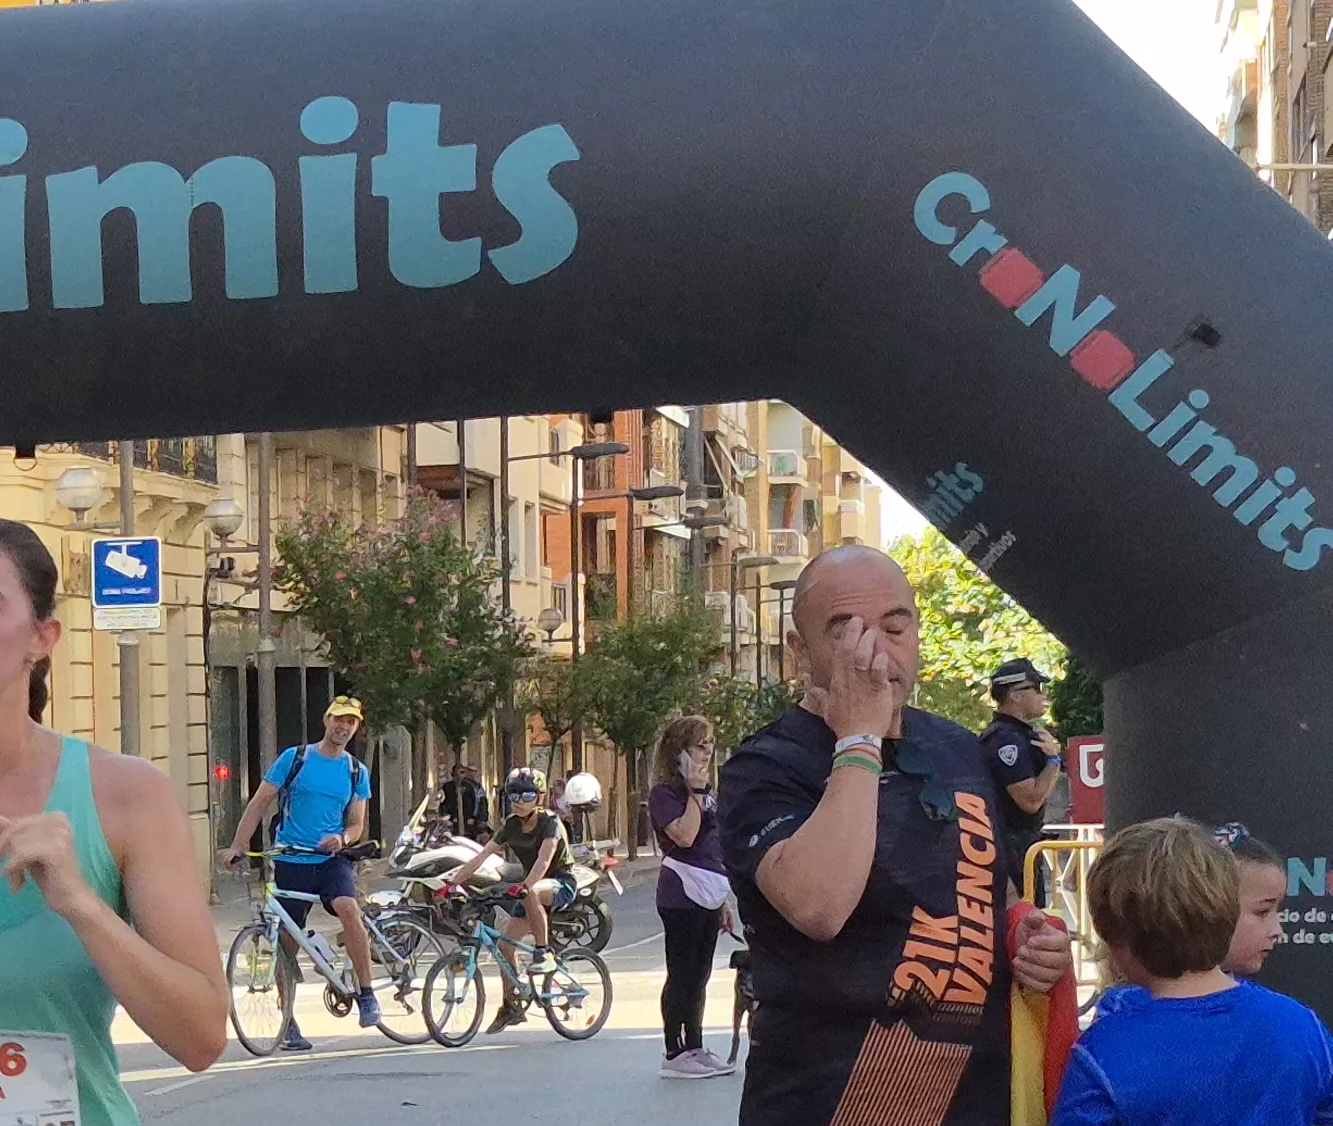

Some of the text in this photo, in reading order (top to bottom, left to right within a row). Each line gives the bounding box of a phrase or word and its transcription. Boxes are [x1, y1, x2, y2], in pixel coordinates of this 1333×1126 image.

[941, 791, 998, 1006] VALENCIA
[1304, 907, 1327, 923] de
[894, 904, 959, 1001] 21K
[1293, 928, 1315, 944] de
